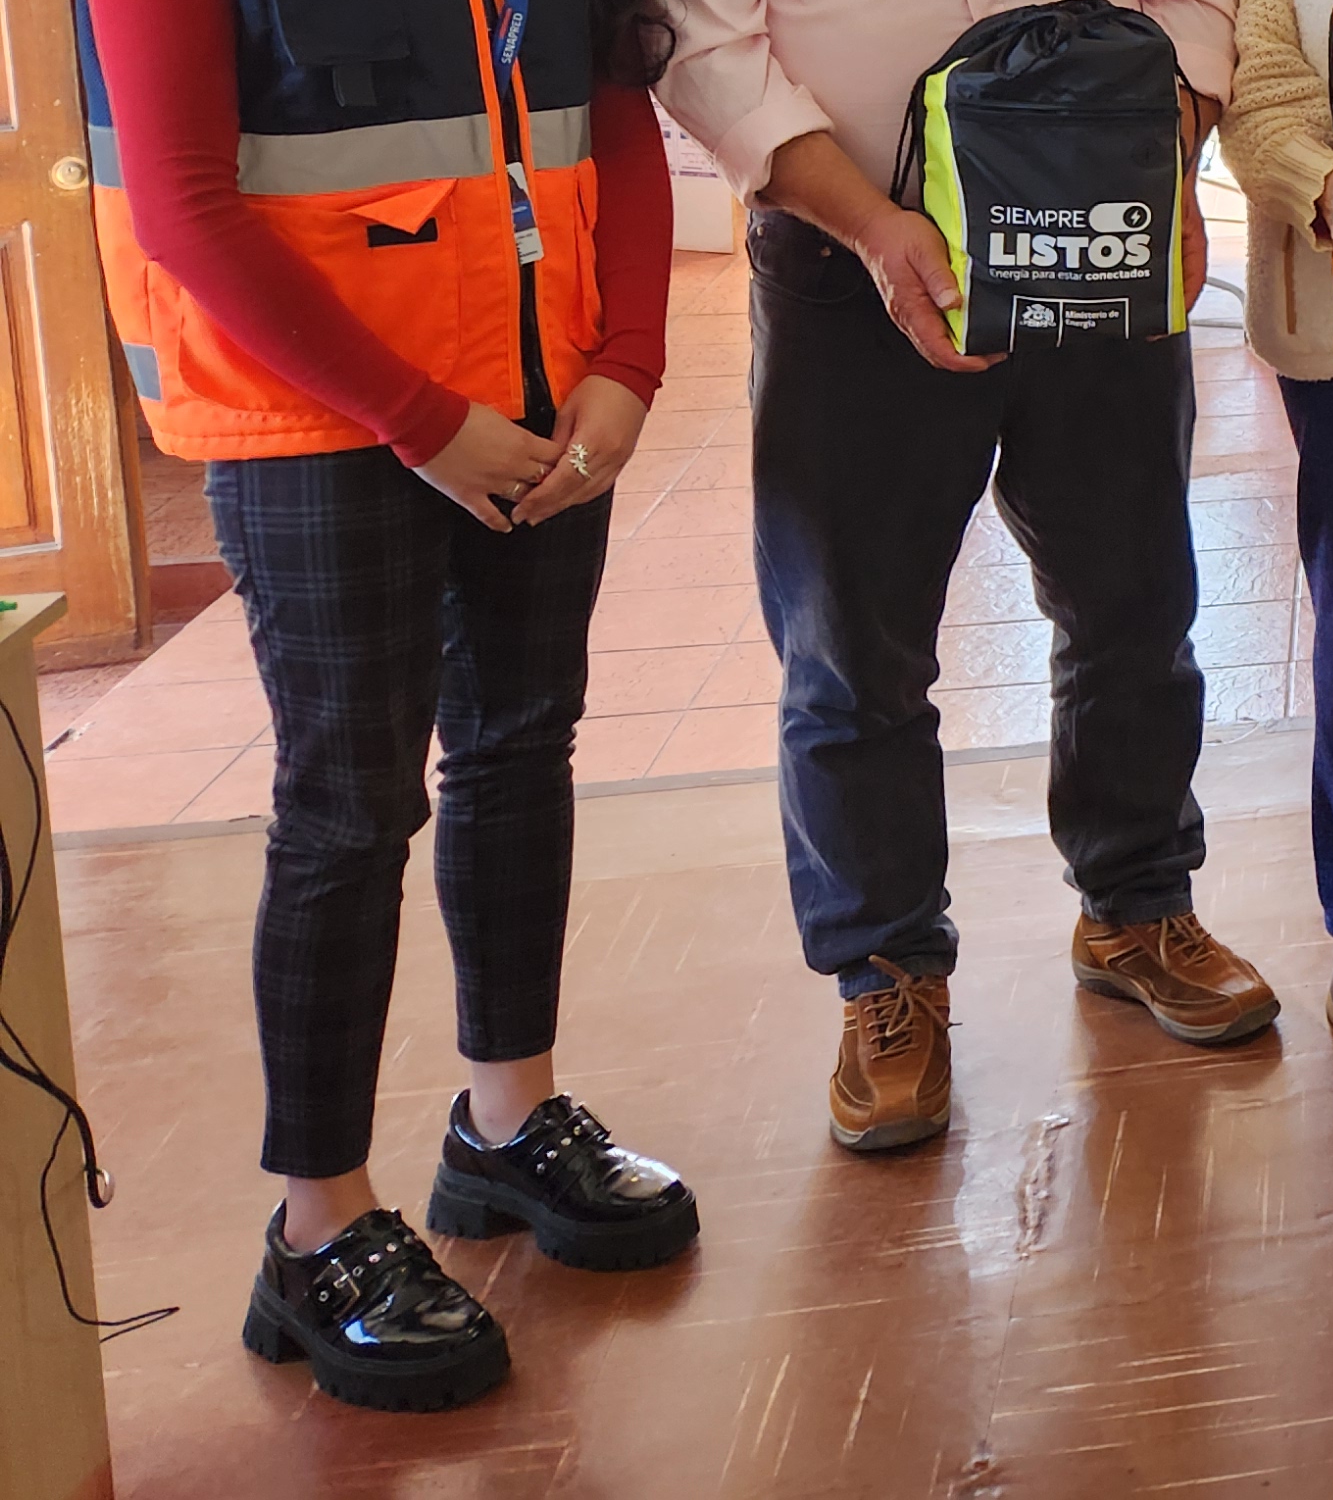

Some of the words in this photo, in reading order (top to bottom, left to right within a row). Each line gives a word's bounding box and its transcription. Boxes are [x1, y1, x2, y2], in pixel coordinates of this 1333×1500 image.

[501, 13, 523, 64] SENAPRED
[990, 206, 1086, 228] SIEMPRE
[989, 232, 1151, 269] LISTOS
[989, 268, 1029, 282] Energía
[1032, 271, 1055, 282] para
[1058, 271, 1082, 281] estar
[1085, 268, 1150, 281] conectados
[1065, 310, 1107, 320] Ministerio
[1108, 310, 1120, 319] de
